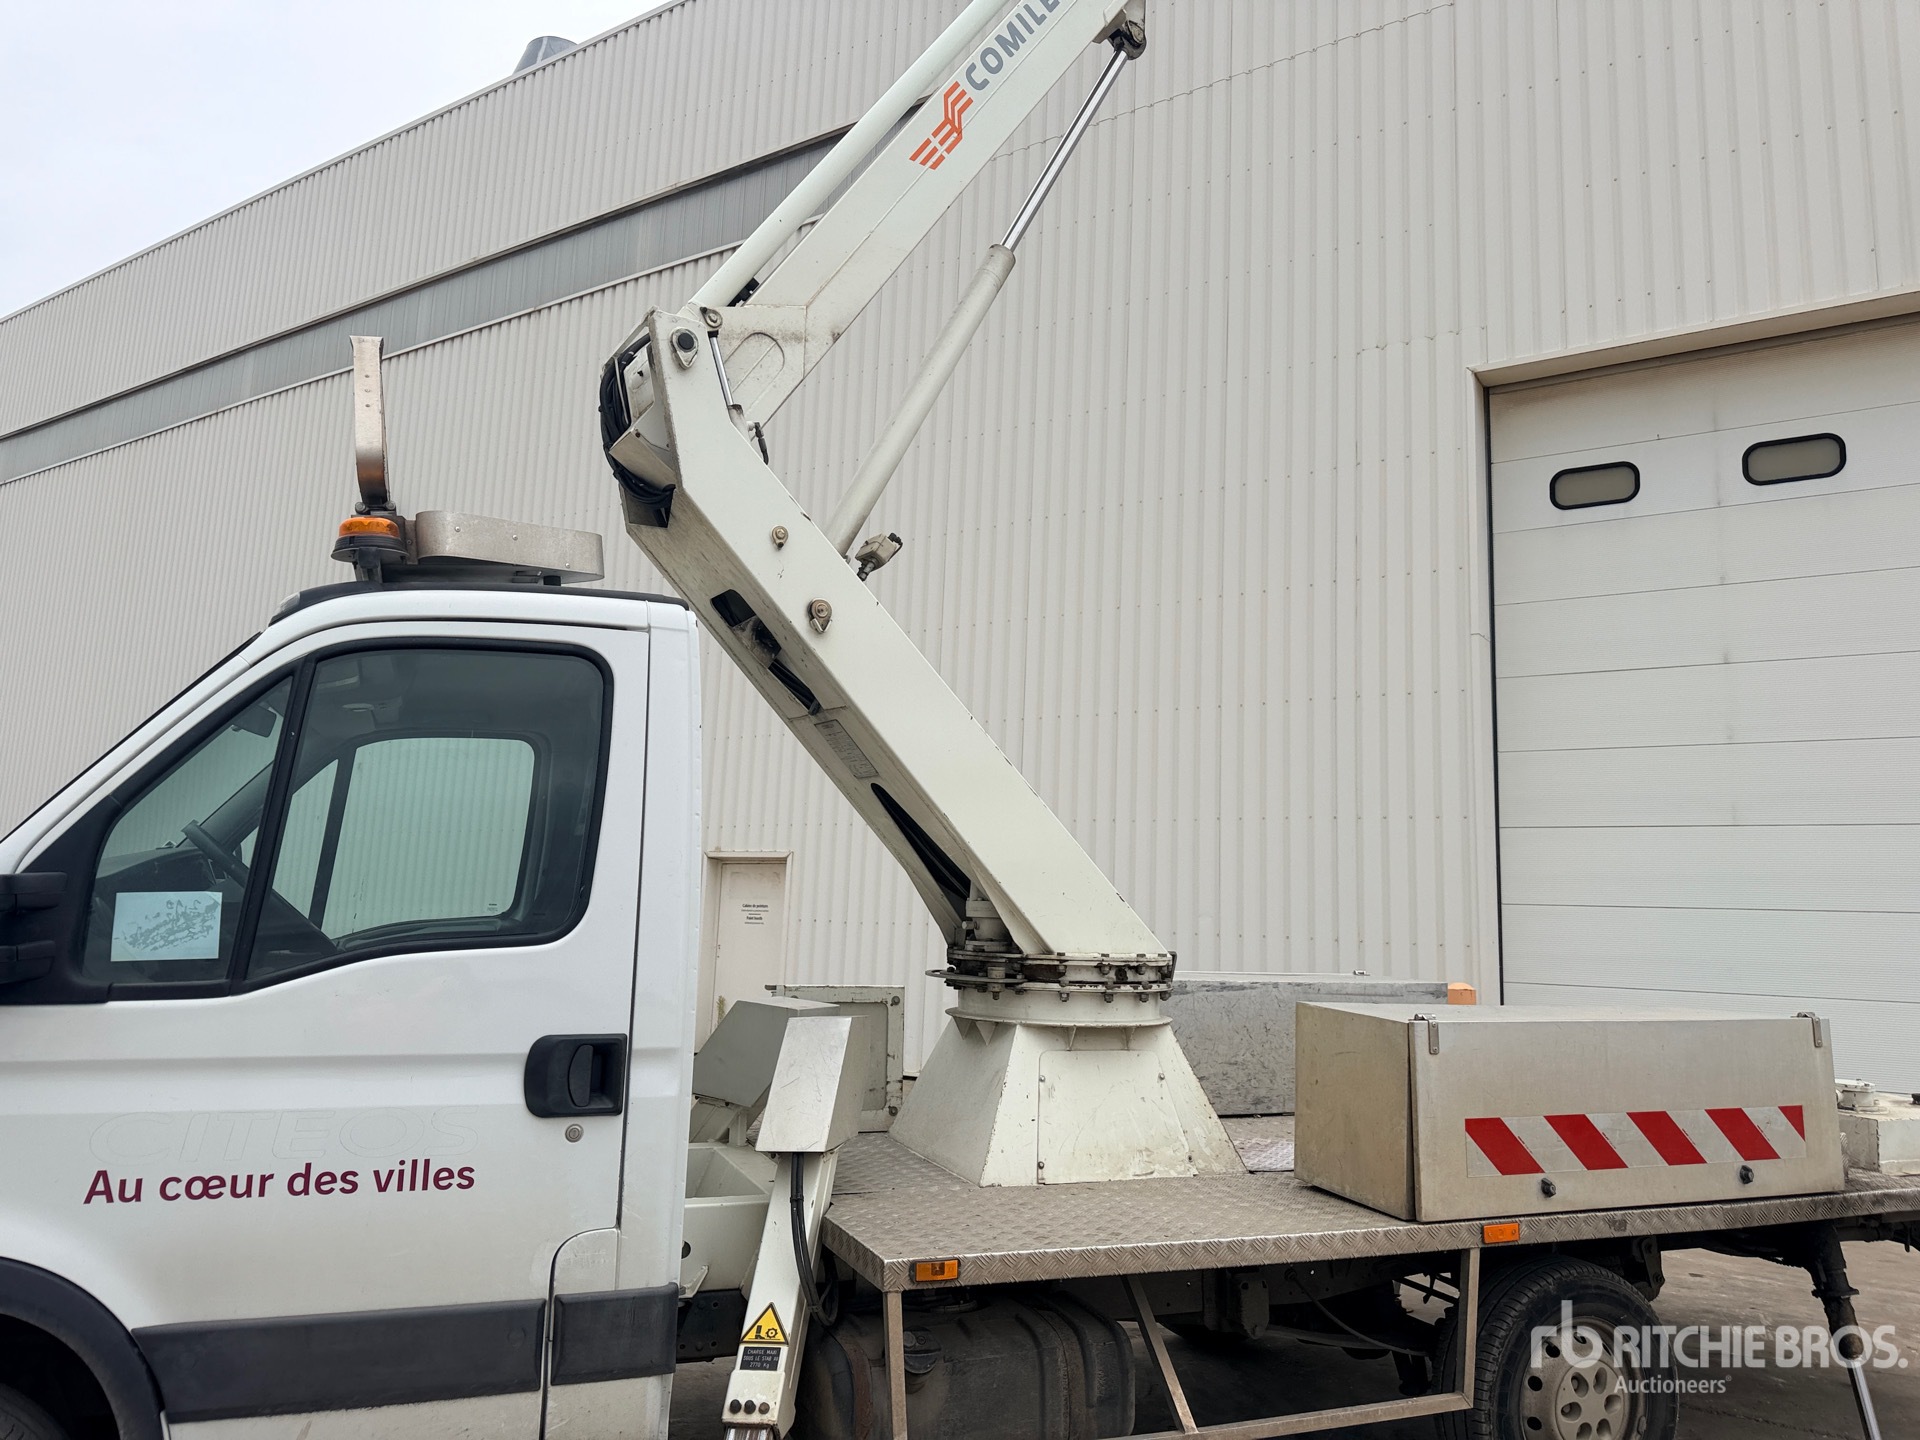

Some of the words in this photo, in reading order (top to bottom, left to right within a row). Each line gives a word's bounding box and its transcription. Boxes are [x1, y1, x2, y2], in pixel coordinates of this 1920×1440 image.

[89, 1105, 479, 1166] CITEOS
[84, 1171, 143, 1203] Au
[159, 1173, 273, 1201] cœur
[287, 1162, 358, 1196] des
[373, 1159, 474, 1192] villes
